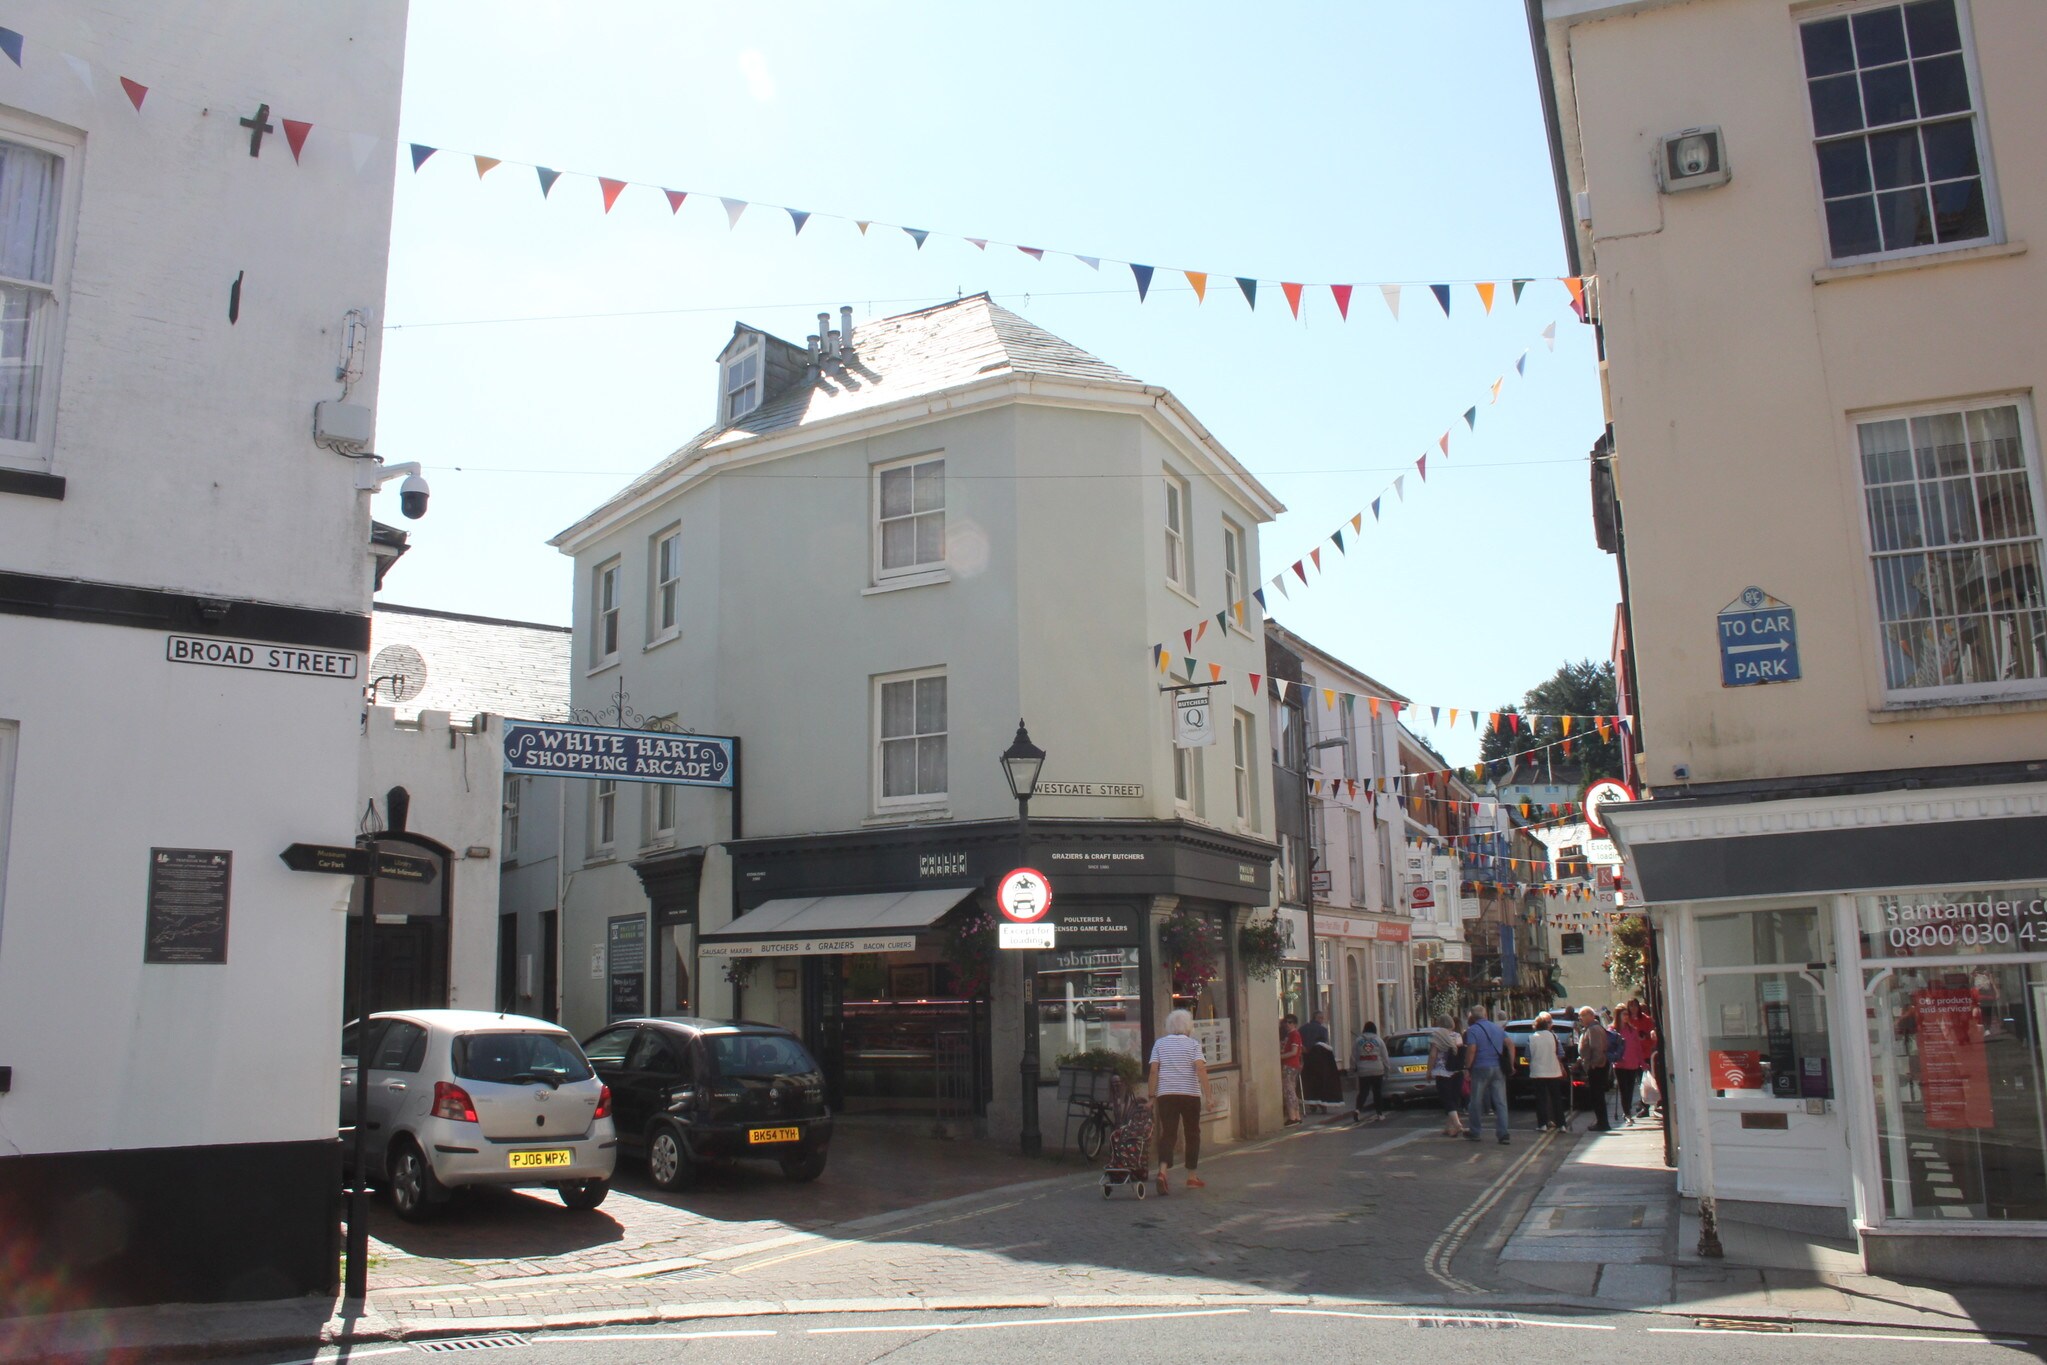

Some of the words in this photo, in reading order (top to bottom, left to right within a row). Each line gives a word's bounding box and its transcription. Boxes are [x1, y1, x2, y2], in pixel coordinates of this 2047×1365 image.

[1721, 620, 1746, 637] TO
[1751, 616, 1790, 634] CAR
[175, 640, 254, 665] BROAD
[268, 650, 352, 675] STREET
[1734, 659, 1788, 679] PARK
[1178, 699, 1208, 707] BUTCHERS
[1186, 708, 1203, 728] Q
[538, 730, 626, 754] WHITE
[636, 738, 700, 759] HART
[525, 750, 628, 772] SHOPPING
[635, 758, 711, 778] ARCADE
[1034, 783, 1091, 795] WESTGATE
[1100, 785, 1140, 796] STREET
[1591, 843, 1615, 851] Excep
[318, 859, 329, 867] Car
[921, 857, 965, 866] PHILIP
[397, 868, 422, 877] Information
[920, 865, 966, 875] WARREN
[1624, 893, 1638, 901] SA
[1887, 896, 2047, 922] santander.c
[1003, 927, 1035, 935] Except
[1889, 925, 1954, 947] 0800
[1962, 922, 2010, 945] 030
[1010, 937, 1043, 945] loading
[761, 944, 799, 953] BUTCHERS
[805, 943, 811, 951] &
[818, 942, 855, 950] GRAZIERS
[1936, 996, 1972, 1006] products
[753, 1130, 777, 1141] BK54
[779, 1129, 796, 1140] TYH
[513, 1153, 542, 1166] PJ06
[545, 1152, 565, 1164] MPX
